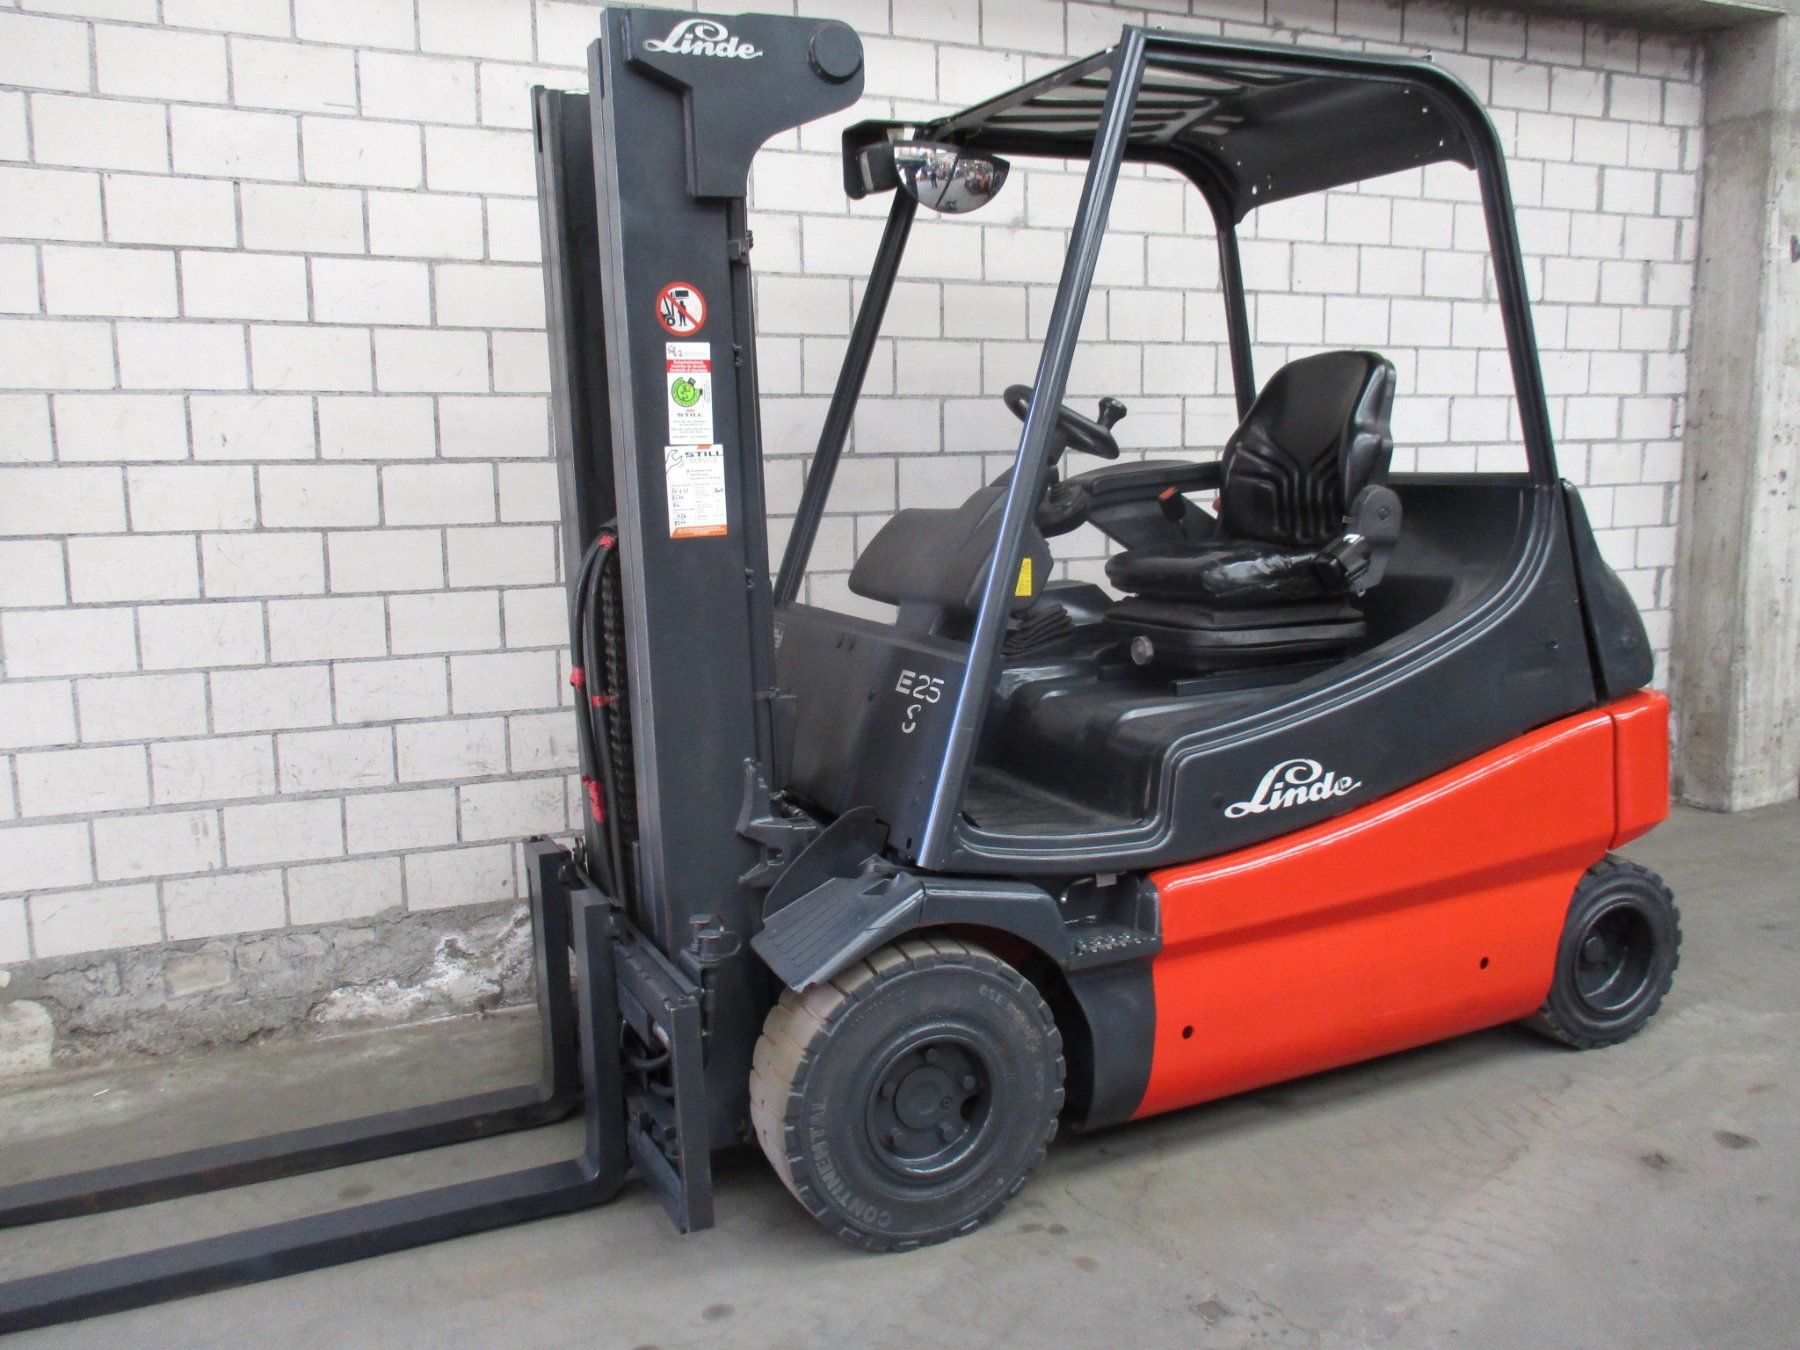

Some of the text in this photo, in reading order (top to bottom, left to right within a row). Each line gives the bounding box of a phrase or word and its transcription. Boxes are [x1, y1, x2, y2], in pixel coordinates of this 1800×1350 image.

[643, 18, 763, 60] Linde
[895, 669, 945, 704] E25
[1224, 758, 1363, 819] Linde
